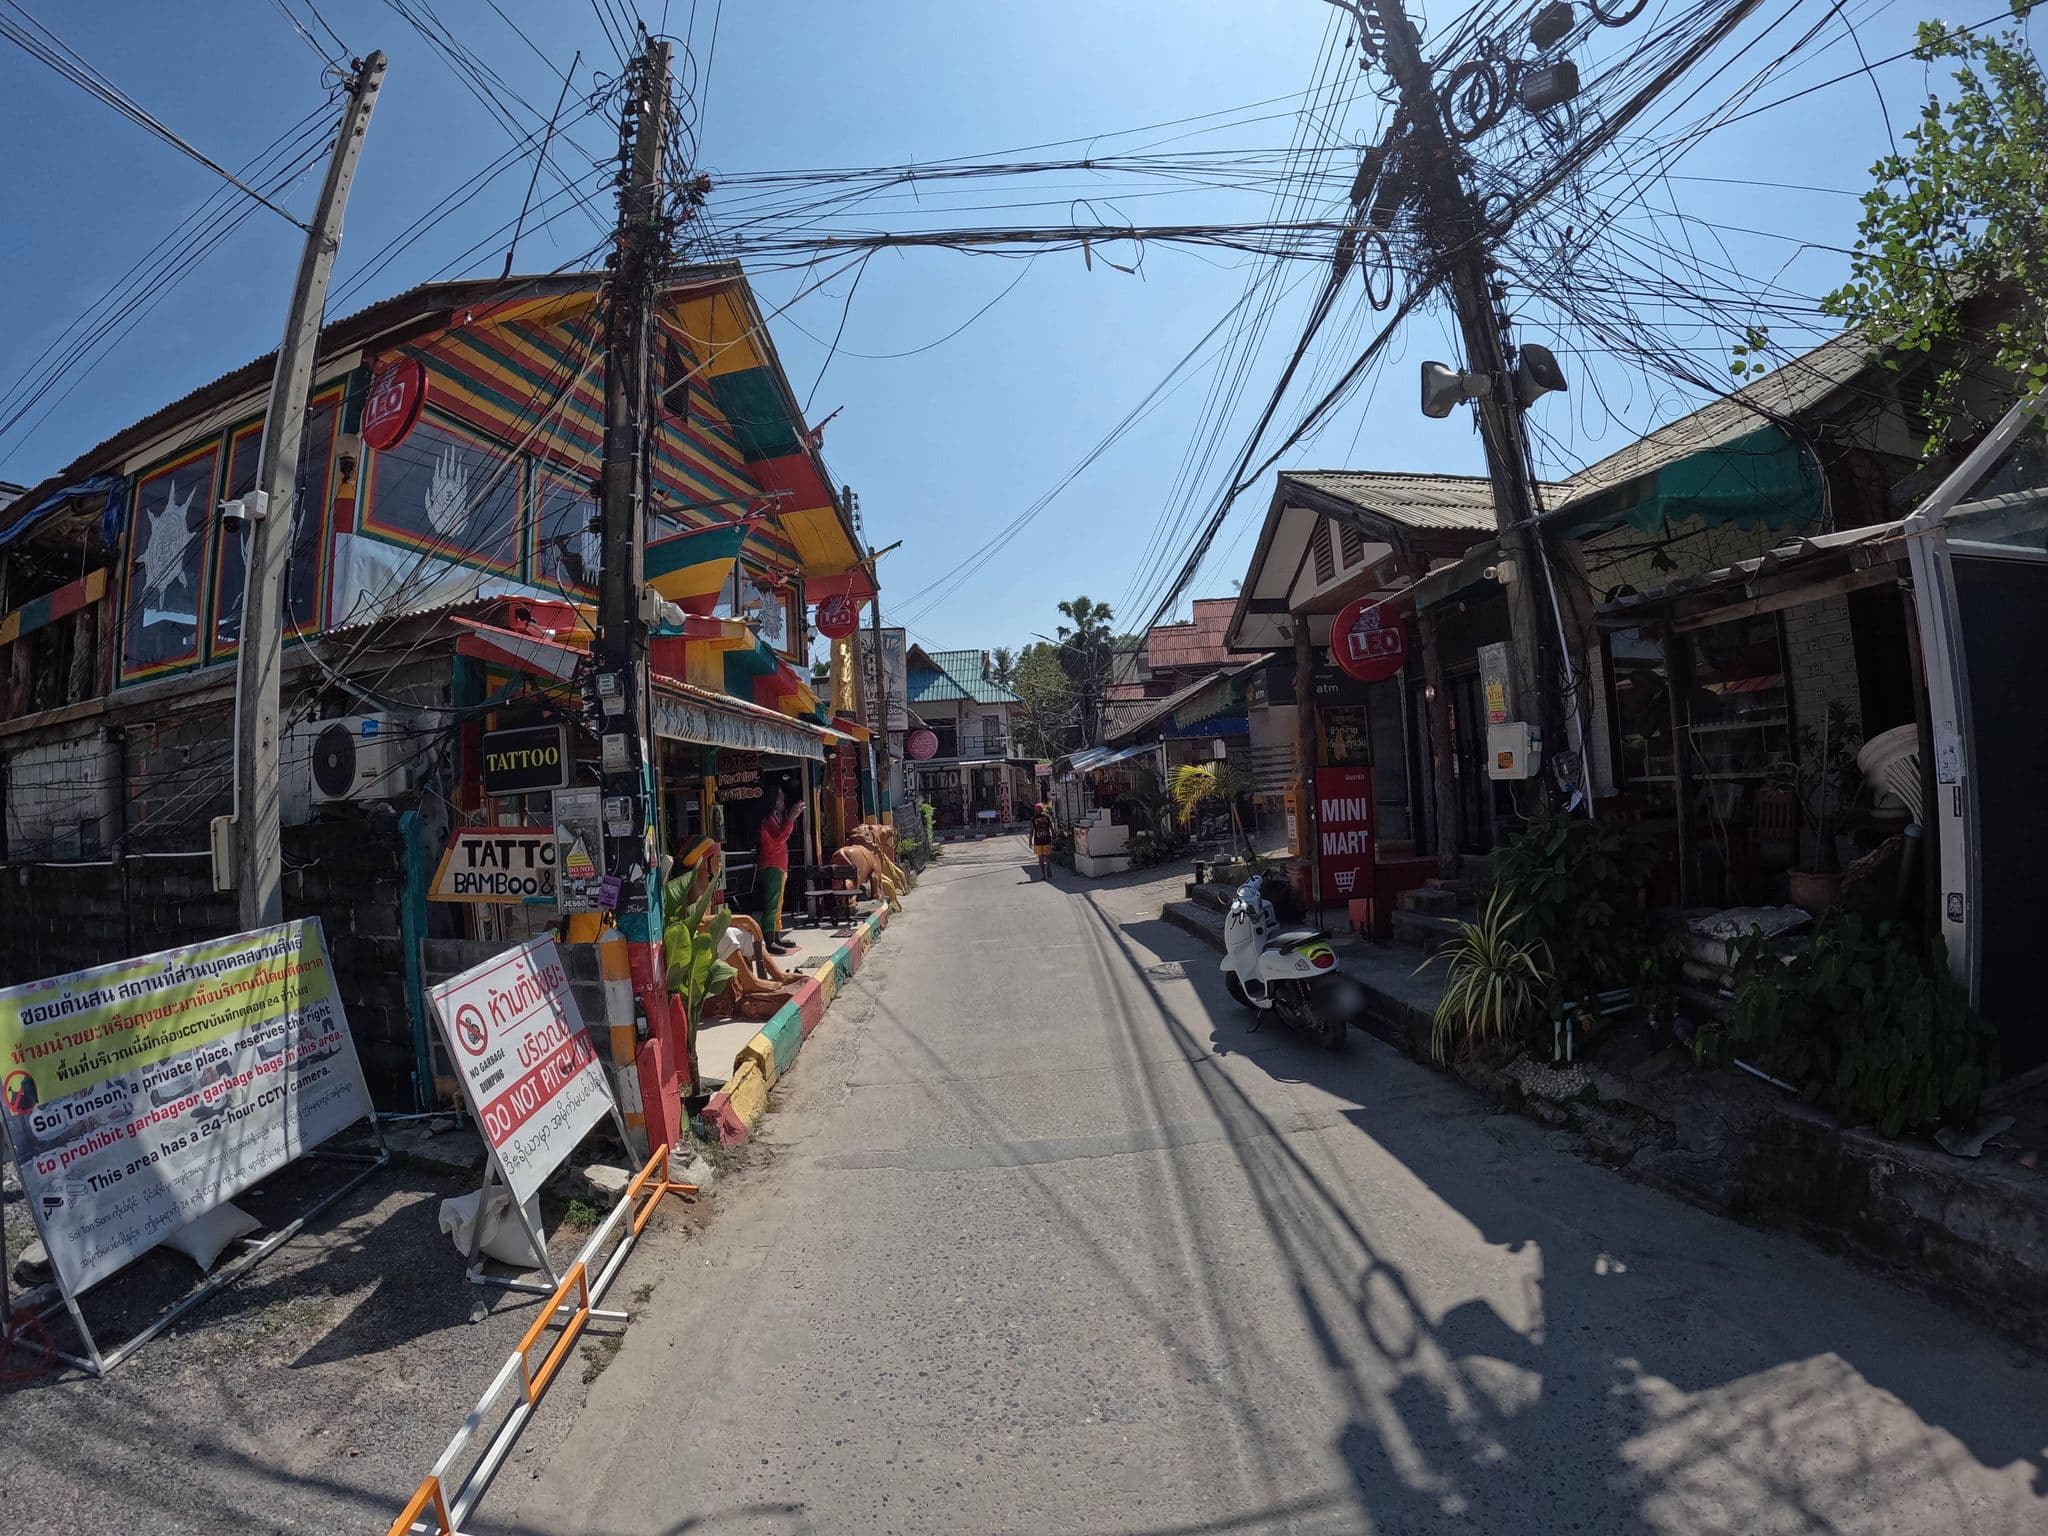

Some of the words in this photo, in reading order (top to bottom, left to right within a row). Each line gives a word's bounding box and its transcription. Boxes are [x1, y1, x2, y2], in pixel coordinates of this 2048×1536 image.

[367, 385, 403, 426] LEO
[1348, 629, 1401, 660] LEO
[1316, 685, 1339, 694] atm
[487, 747, 558, 772] TATTOO
[1322, 797, 1367, 822] MINI
[1323, 831, 1368, 856] MART
[454, 872, 537, 895] BAMBOO
[20, 986, 116, 1027] ซอยต้นสน
[266, 994, 281, 1008] 24
[488, 962, 564, 1028] ห้ามทิ้งขยะ
[517, 1000, 571, 1068] บริเวณนี้
[32, 1105, 62, 1134] Soi
[62, 1087, 129, 1121] Tonson,
[130, 1080, 140, 1094] a
[142, 1060, 193, 1090] private
[194, 1044, 232, 1075] place,
[234, 1026, 285, 1052] reserves
[286, 1014, 306, 1031] the
[306, 1004, 331, 1025] right
[469, 1066, 480, 1080] NO
[479, 1048, 506, 1074] GARBAGE
[480, 1069, 505, 1094] DUMPING
[485, 1103, 510, 1141] DO
[509, 1078, 546, 1118] NOT
[539, 1052, 578, 1096] PITCH
[36, 1157, 56, 1176] to
[60, 1126, 123, 1168] prohibit
[126, 1093, 201, 1139] garbageor
[203, 1074, 254, 1105] garbage
[255, 1056, 283, 1078] bags
[283, 1050, 296, 1065] in
[295, 1040, 317, 1059] this
[317, 1031, 344, 1050] area.
[88, 1169, 123, 1194] This
[126, 1151, 160, 1176] area
[161, 1136, 187, 1158] has
[190, 1132, 199, 1145] a
[201, 1100, 257, 1139] 24-hour
[257, 1084, 289, 1111] CCTV
[289, 1066, 331, 1092] camera.
